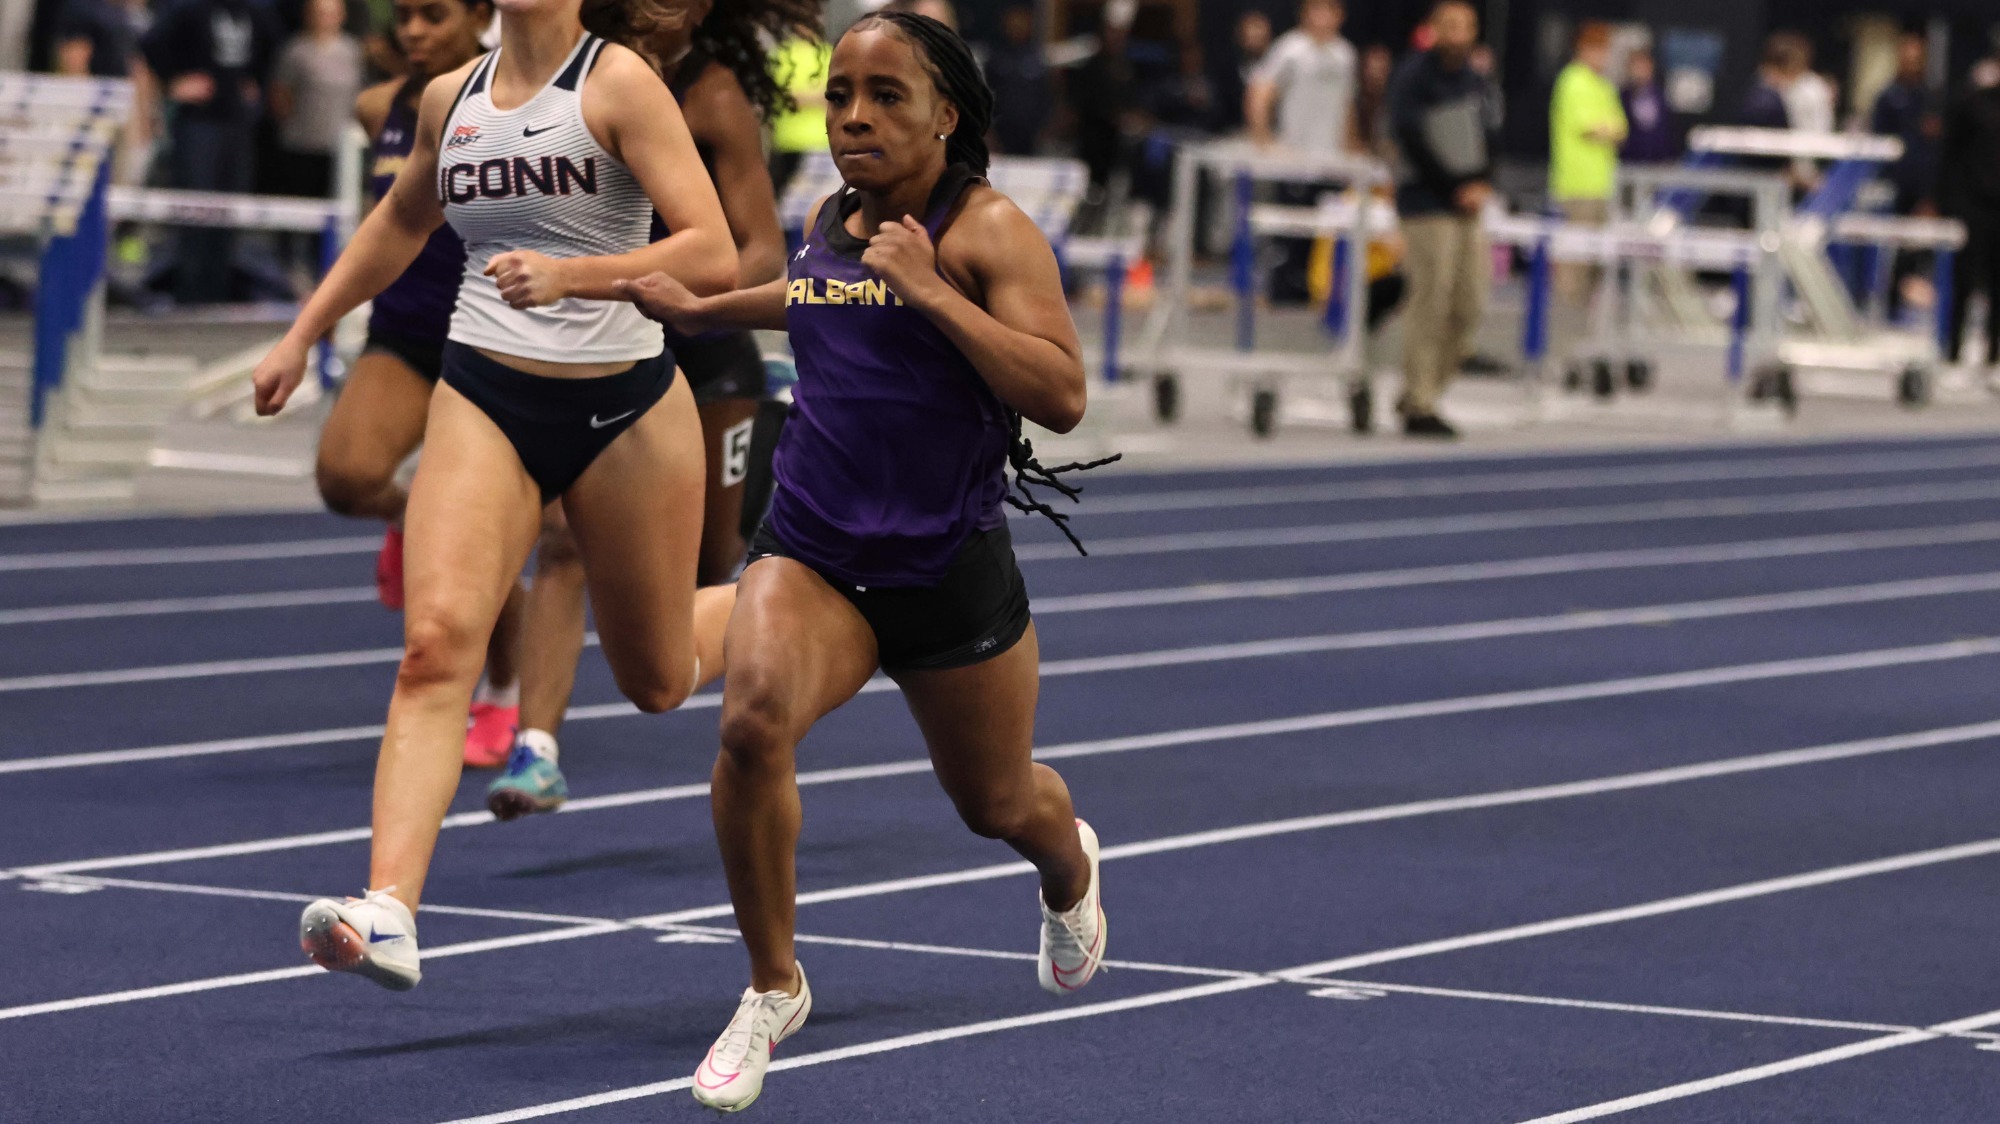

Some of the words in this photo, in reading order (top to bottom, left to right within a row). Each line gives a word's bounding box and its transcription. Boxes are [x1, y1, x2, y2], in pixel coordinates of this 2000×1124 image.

[447, 135, 481, 146] EAST
[454, 126, 480, 136] BIG
[441, 156, 598, 208] CONN
[730, 428, 749, 477] 5
